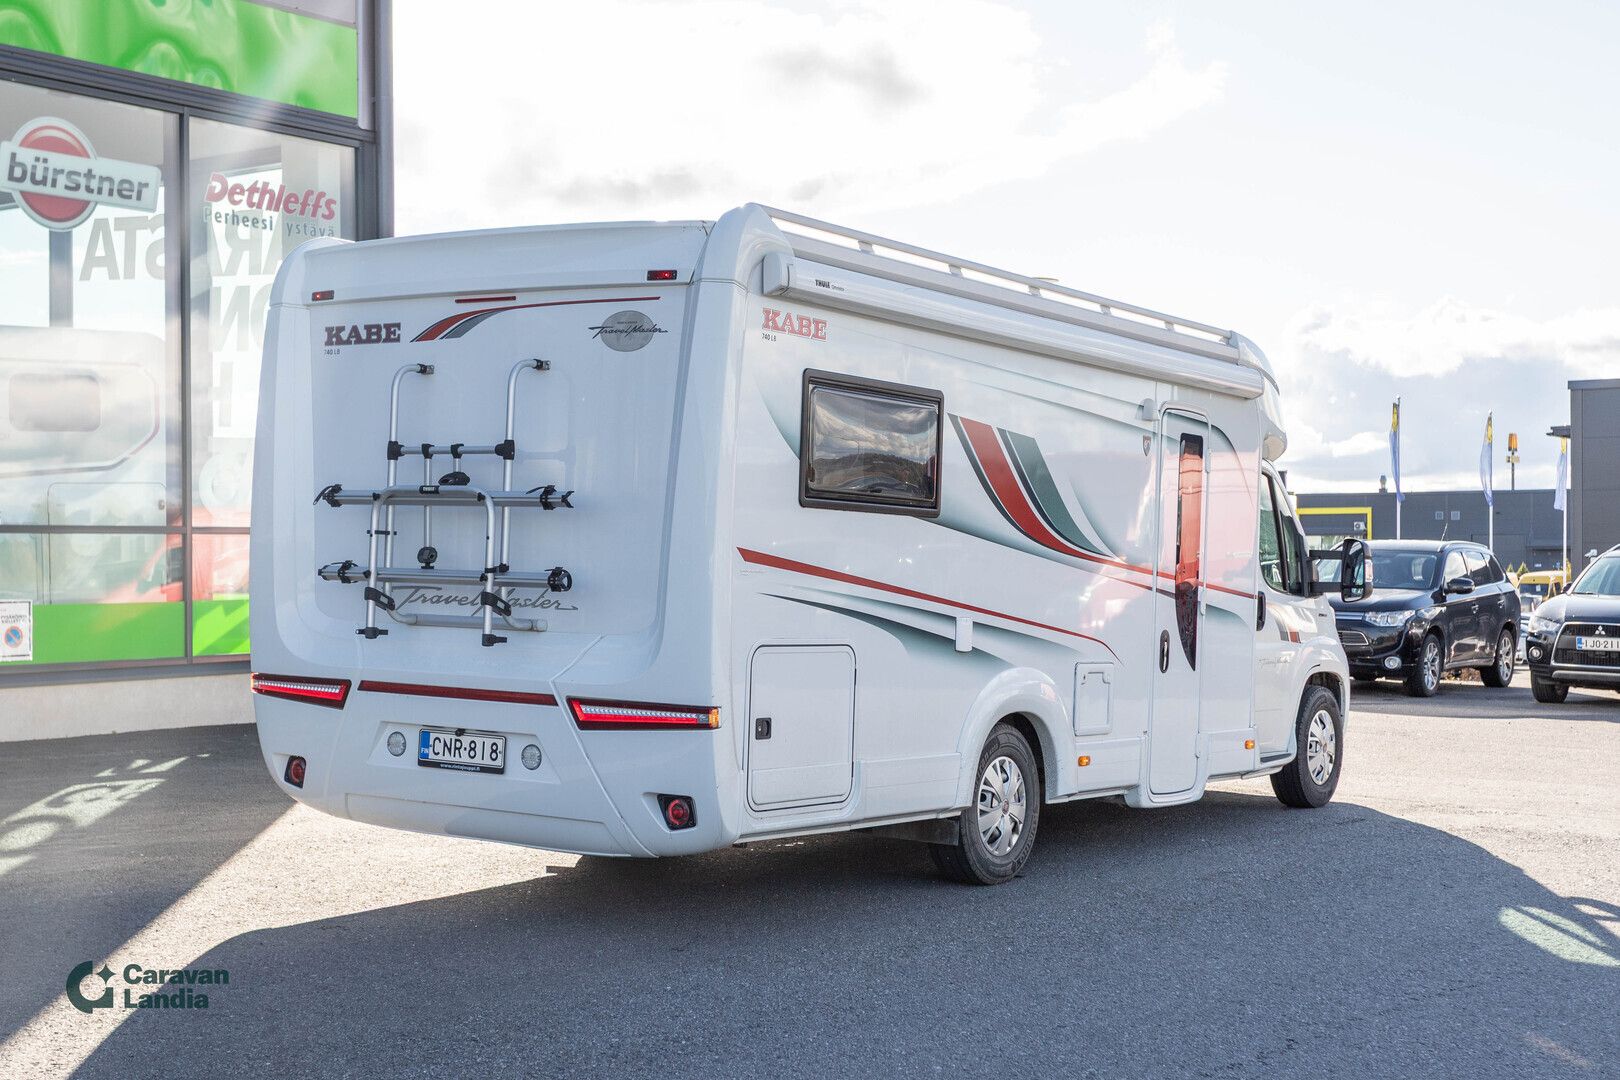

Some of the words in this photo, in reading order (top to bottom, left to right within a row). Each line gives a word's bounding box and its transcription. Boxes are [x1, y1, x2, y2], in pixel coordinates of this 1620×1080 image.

[7, 152, 149, 201] bürstner
[205, 171, 337, 220] Dethleffs
[204, 206, 273, 231] Perheesi
[286, 222, 335, 238] ystävä
[325, 322, 401, 347] KABE
[762, 307, 827, 342] KABE
[432, 736, 499, 762] CNR-818
